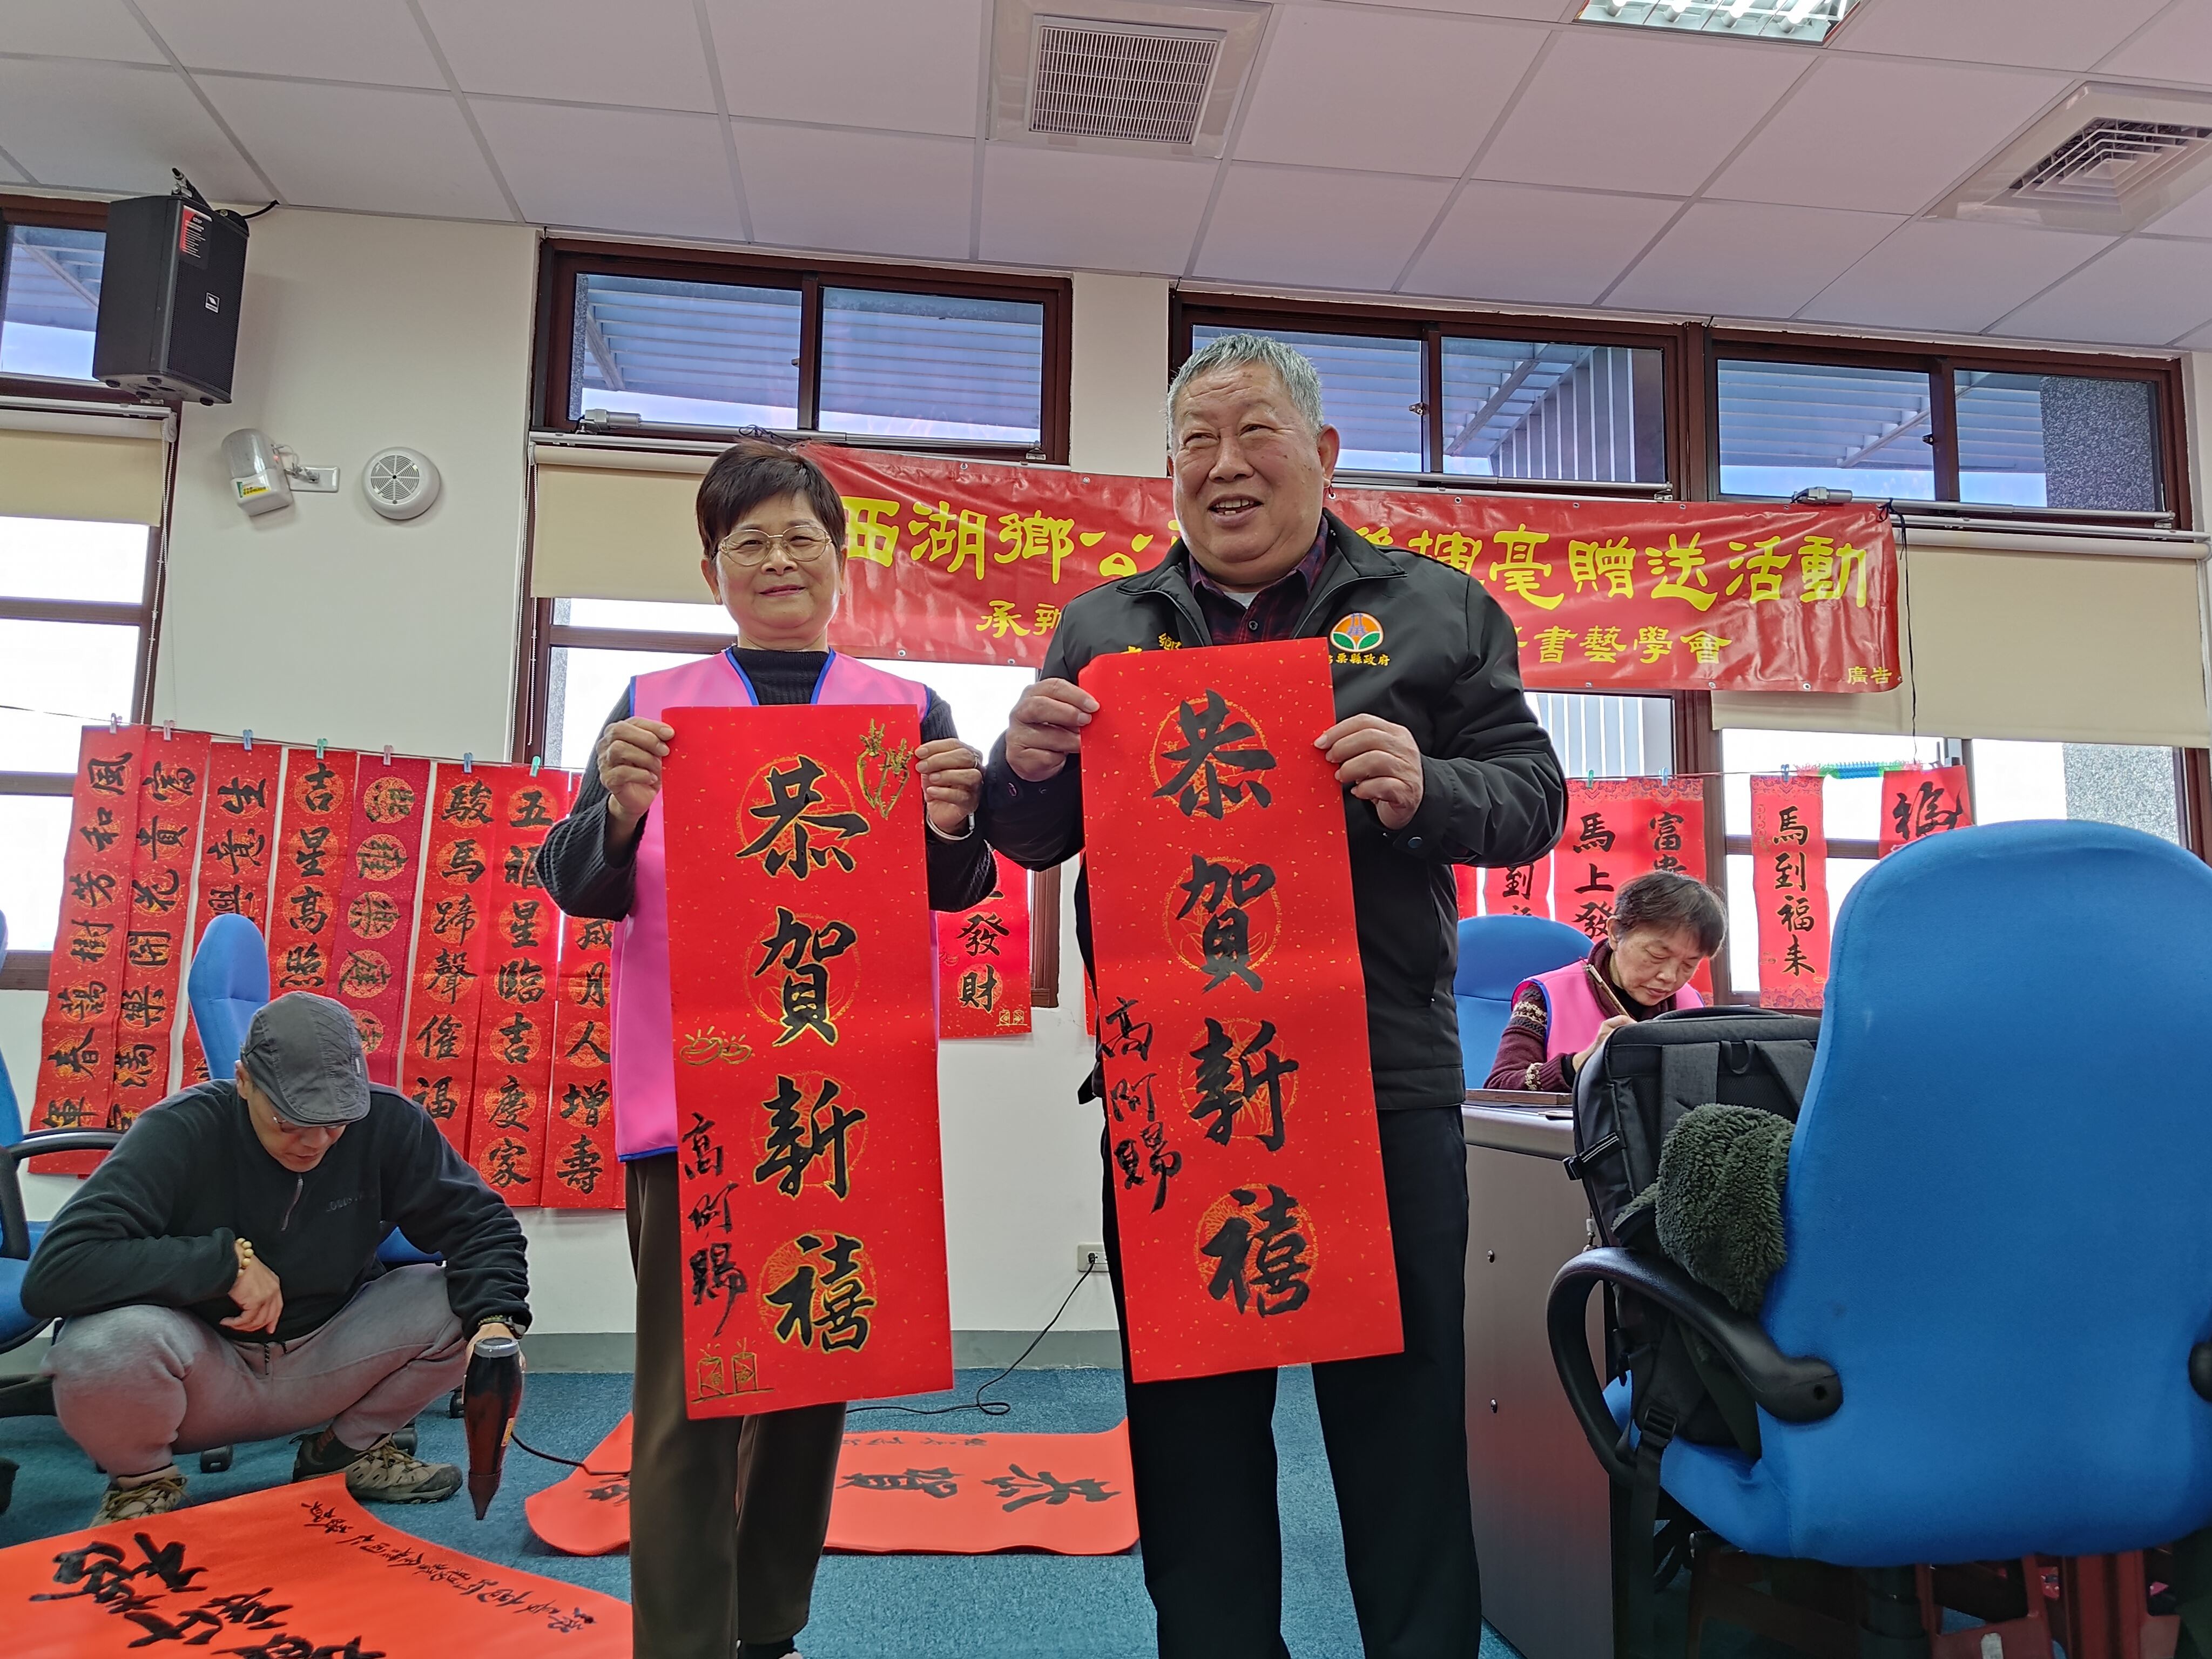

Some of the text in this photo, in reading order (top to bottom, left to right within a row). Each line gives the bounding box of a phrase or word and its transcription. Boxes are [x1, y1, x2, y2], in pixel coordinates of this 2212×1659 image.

[840, 495, 1181, 584] 西湖鄉公
[1355, 523, 1867, 611] 揮毫贈送活動
[1514, 625, 1732, 664] 書藝學會
[1847, 666, 1892, 685] 廣告
[279, 762, 338, 988] 吉星高照
[956, 890, 1010, 1013] 發財
[1151, 688, 1311, 1318] 恭賀新禧
[736, 755, 878, 1354] 恭賀新禧
